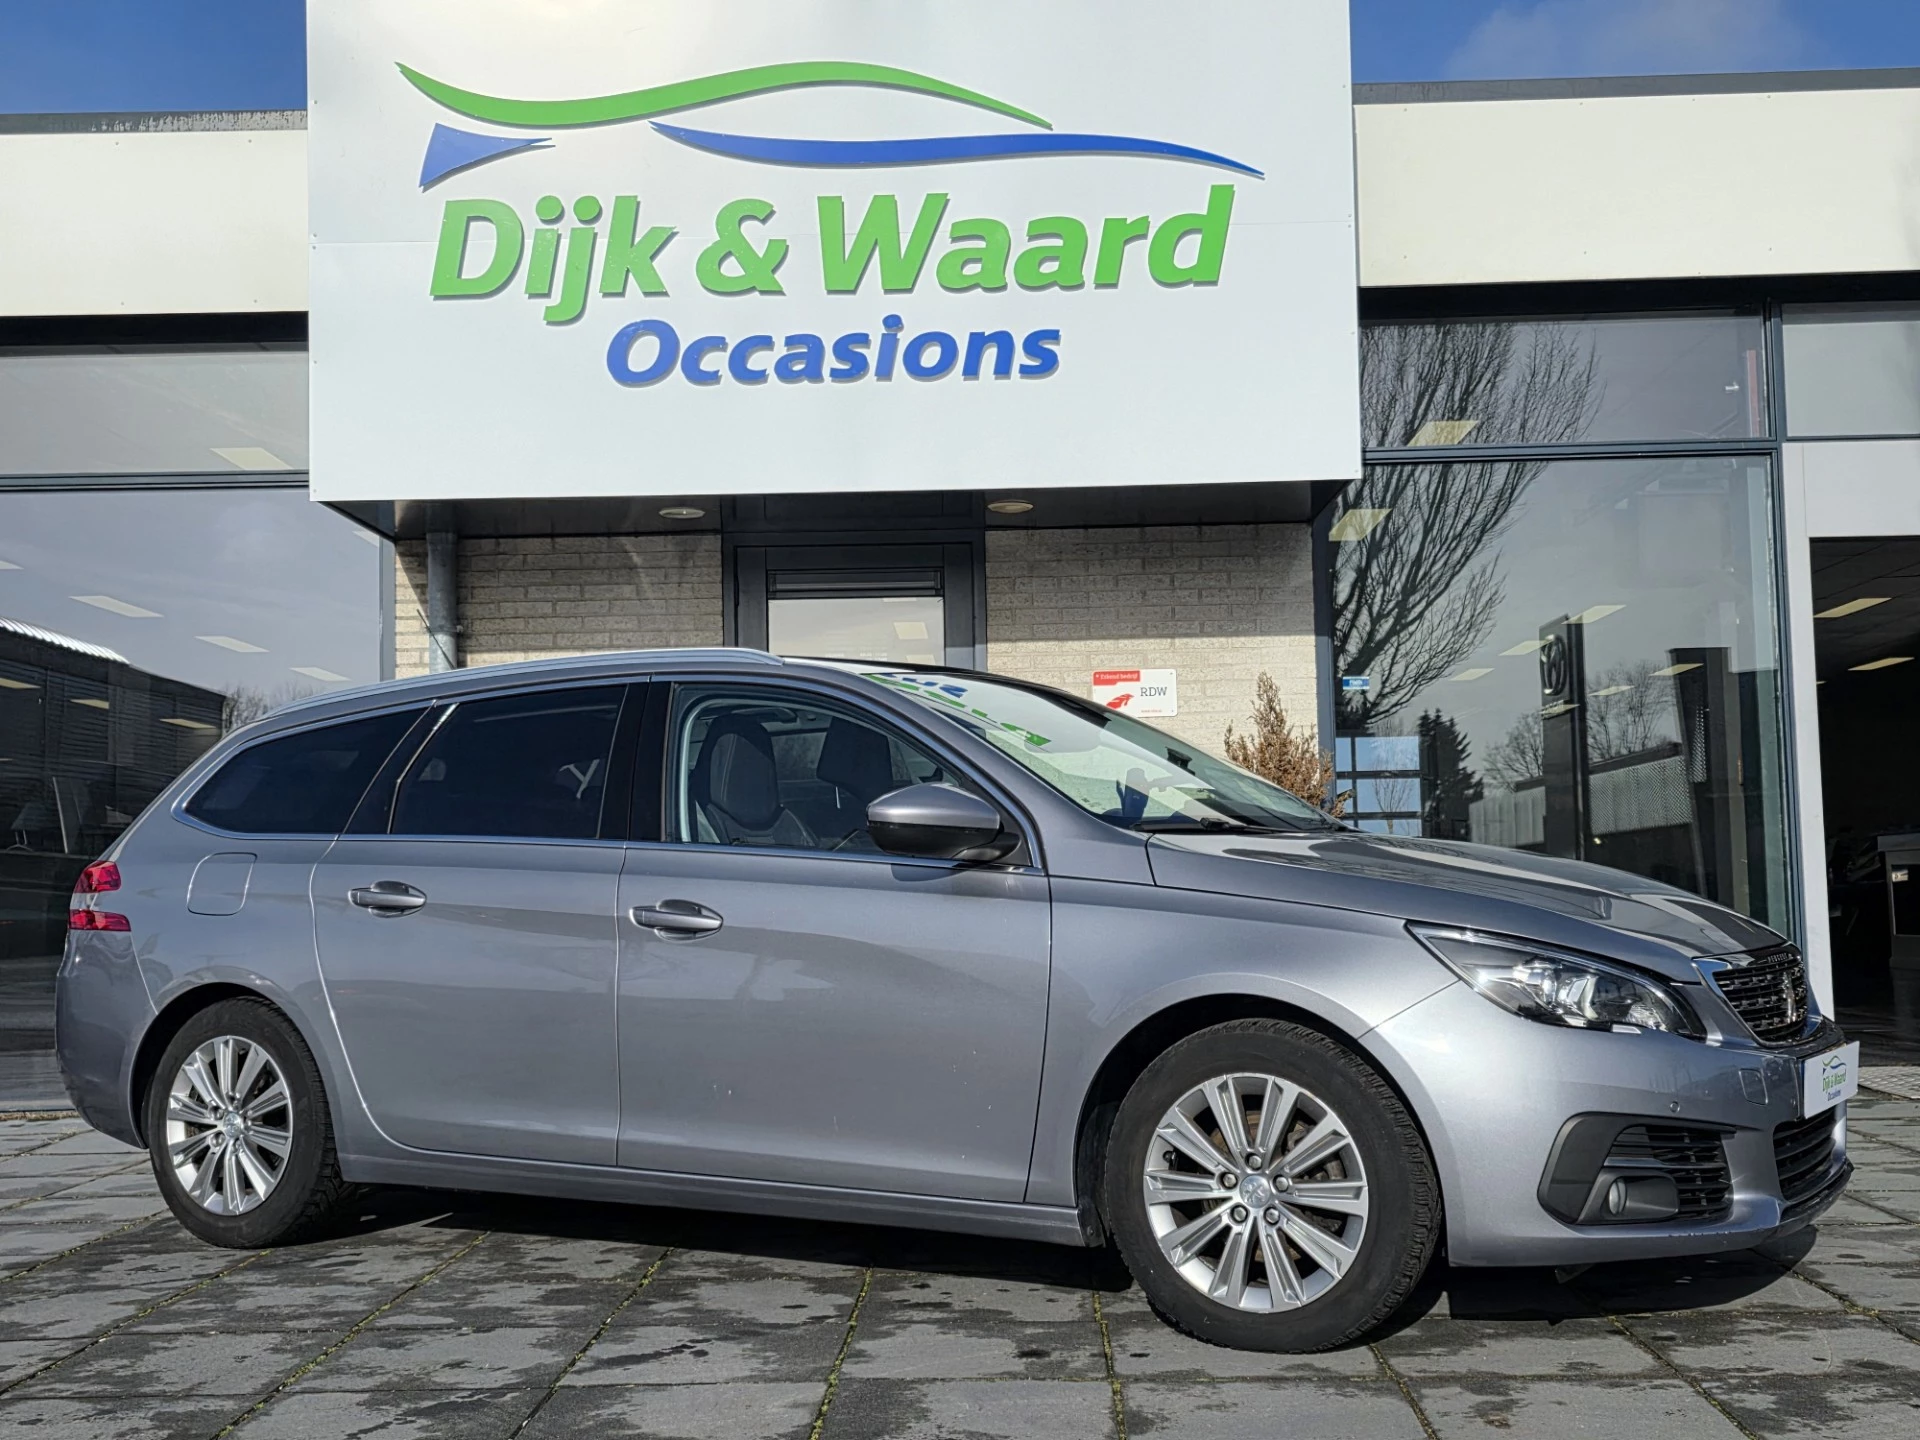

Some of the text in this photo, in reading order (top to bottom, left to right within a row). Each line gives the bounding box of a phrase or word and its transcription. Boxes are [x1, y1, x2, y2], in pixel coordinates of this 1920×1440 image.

[430, 184, 1235, 323] Dijk & Waard
[606, 314, 1061, 387] Occasions
[1140, 687, 1167, 697] RDW
